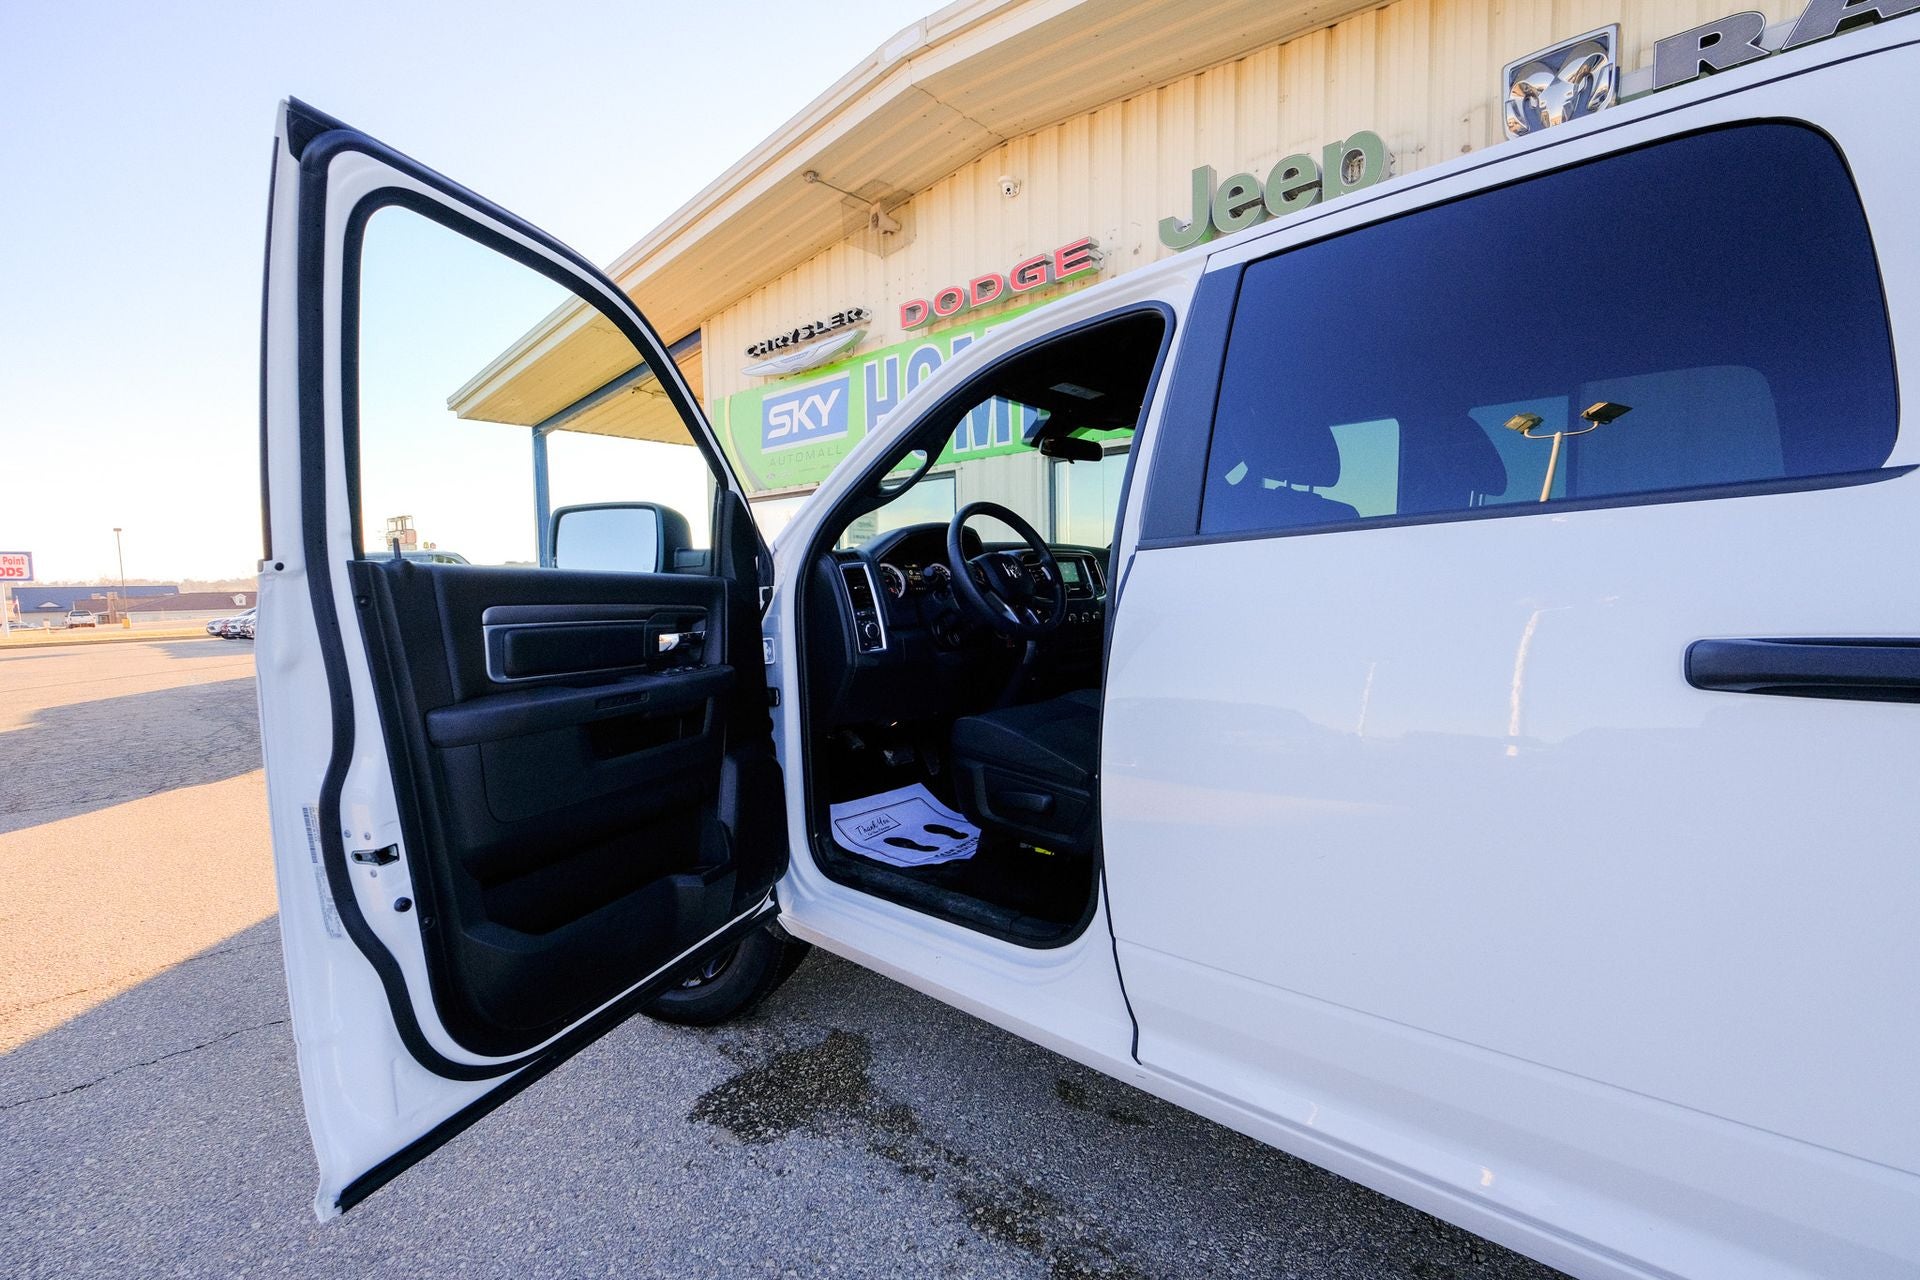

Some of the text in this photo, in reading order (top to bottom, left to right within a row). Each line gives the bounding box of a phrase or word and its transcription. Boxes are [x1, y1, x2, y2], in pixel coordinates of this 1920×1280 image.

[1158, 130, 1386, 248] Jeep
[900, 236, 1098, 331] DODGE
[744, 307, 868, 358] CHRYSLER
[767, 388, 841, 440] SKY
[768, 444, 842, 467] AUTOMALL
[2, 556, 25, 566] Point
[855, 820, 878, 835] Thank
[876, 817, 890, 827] You
